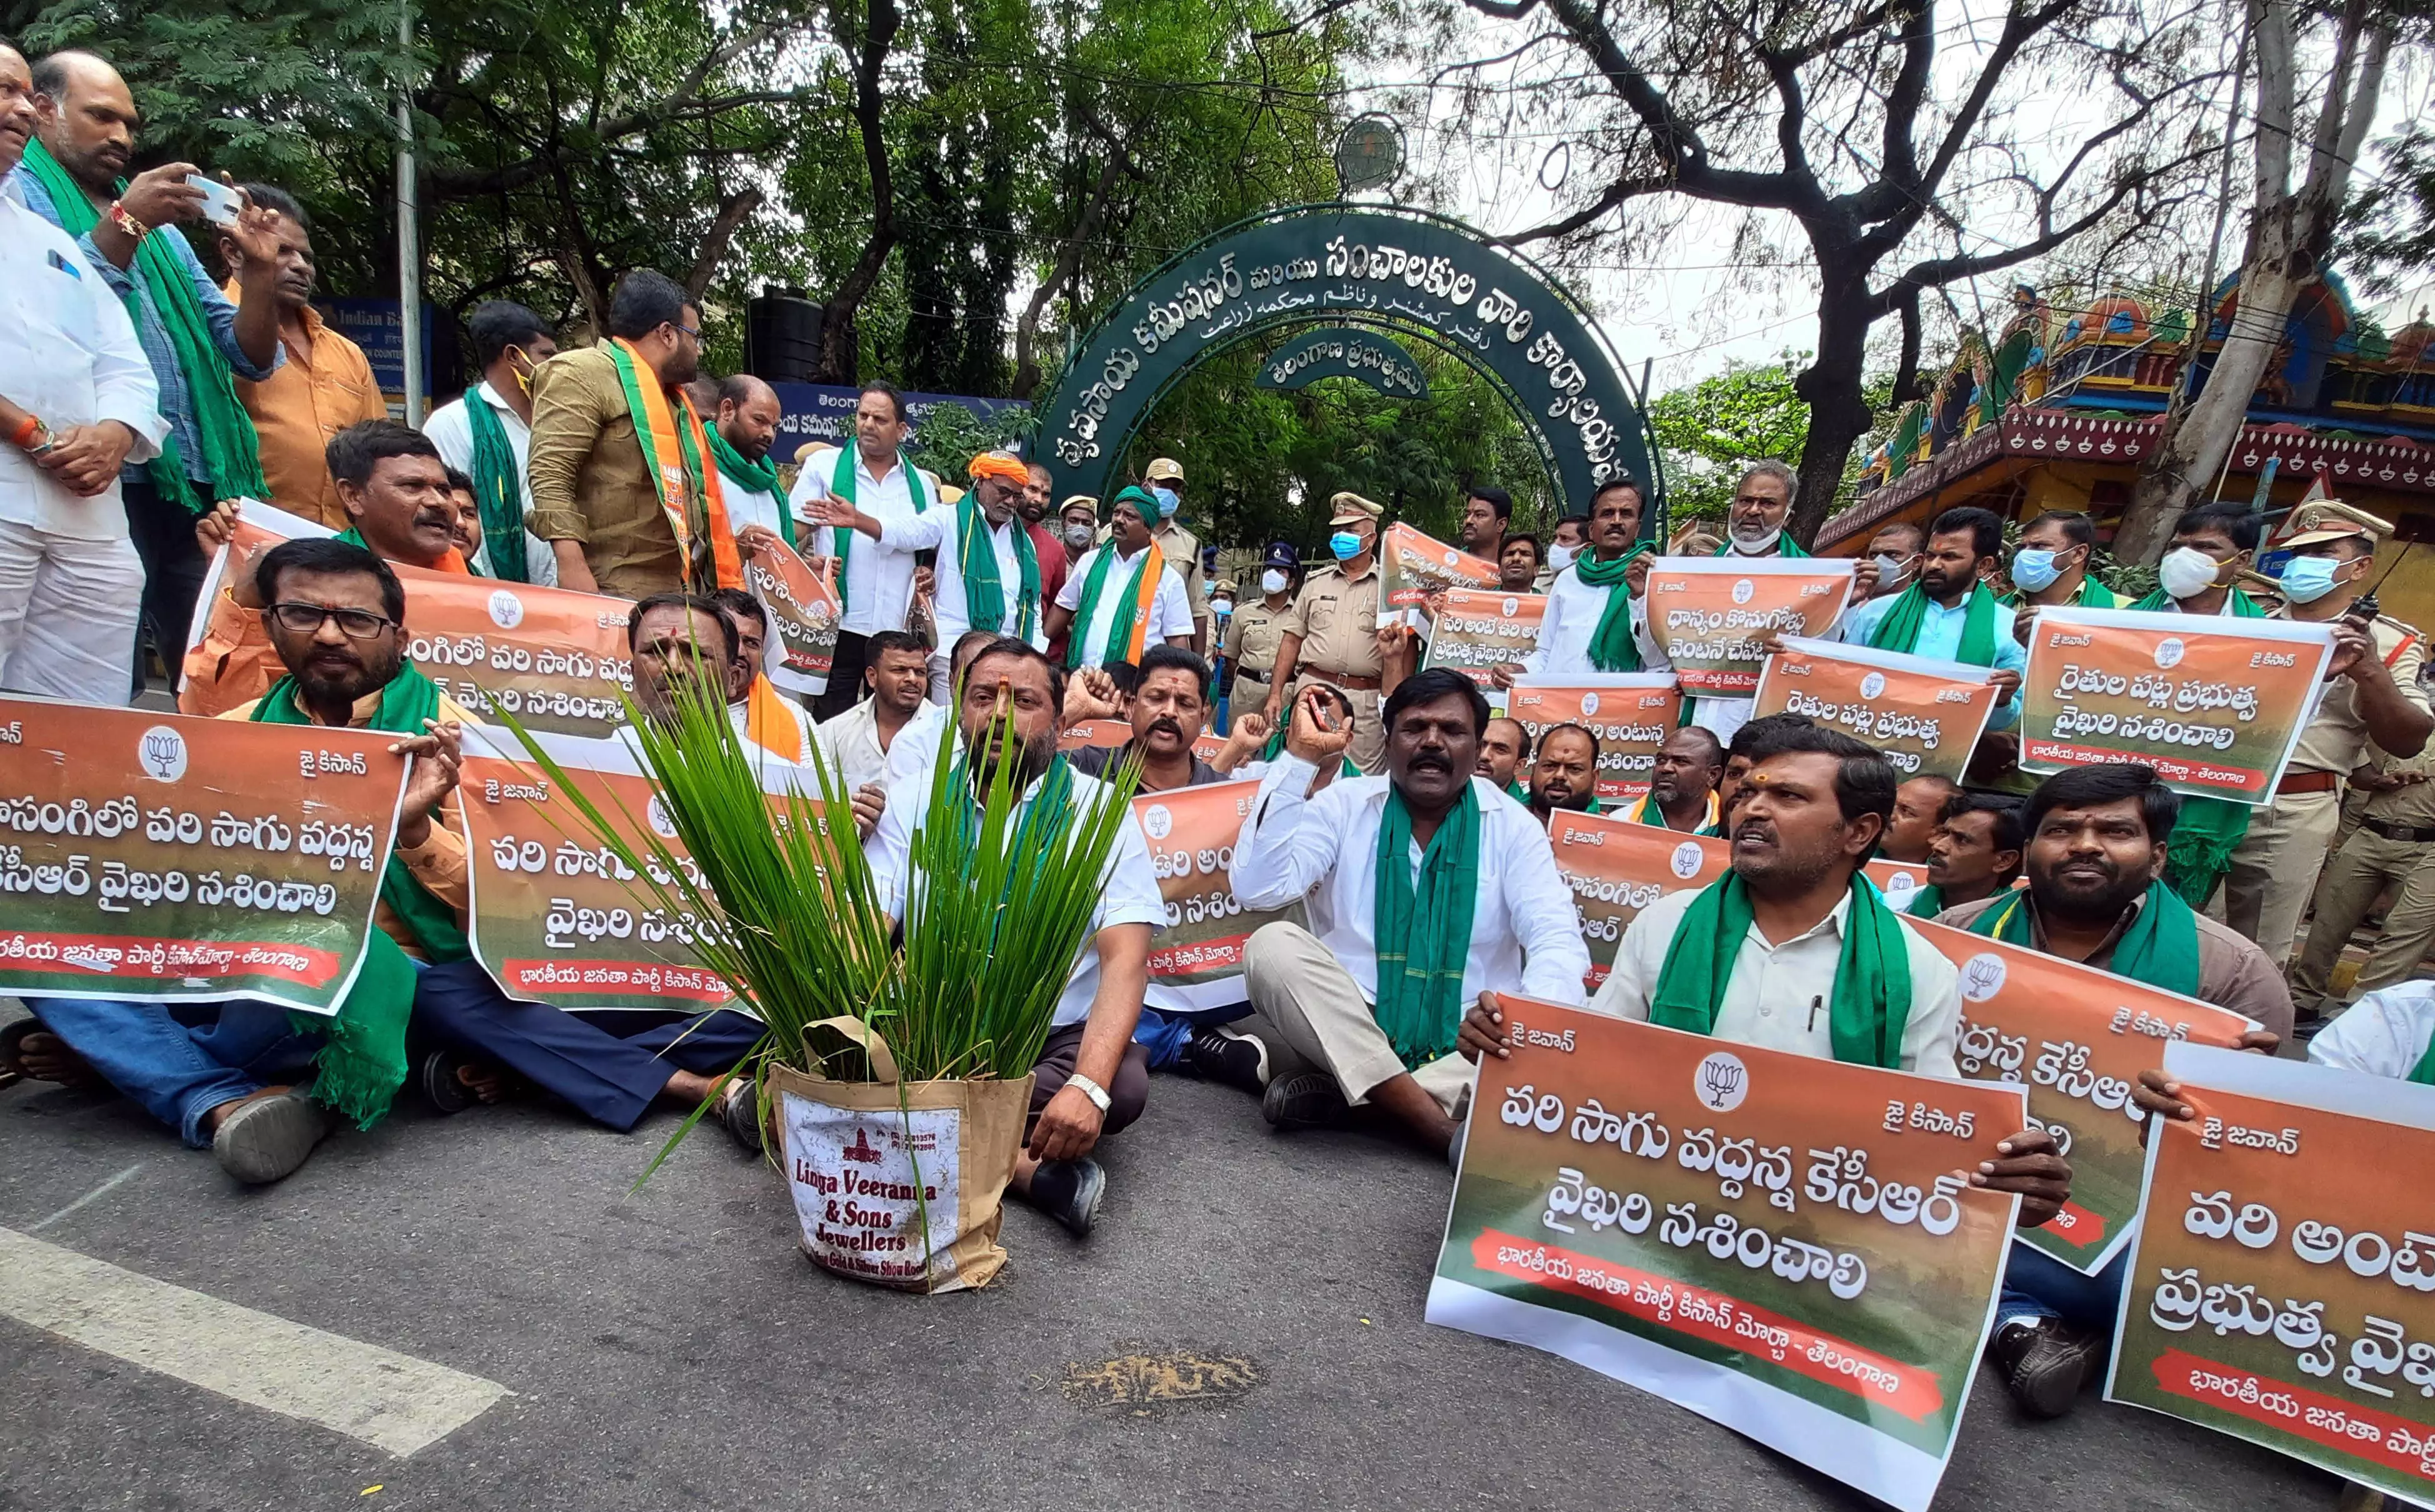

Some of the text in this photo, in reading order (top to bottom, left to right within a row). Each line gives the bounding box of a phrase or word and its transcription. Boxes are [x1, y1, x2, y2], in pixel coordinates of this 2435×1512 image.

[1132, 252, 1242, 353] కమీషనర్
[1249, 257, 1317, 290] మరియు
[1326, 236, 1476, 305] సంచాలకుల
[1477, 288, 1533, 342] వారి
[339, 311, 382, 326] Indian
[1268, 340, 1421, 396] తెలంగాణ ప్రభుత్వము
[1444, 617, 1520, 637] వరి అంటే ఉరి
[1667, 605, 1806, 639] ధాన్యం కొనుగోళ్లు
[1434, 640, 1473, 665] ప్రభుత్వ
[1473, 644, 1507, 666] వైఖరి
[1667, 637, 1724, 660] వెంటనే
[2050, 633, 2091, 648] జై జవాన్
[491, 644, 531, 672] వరి
[536, 648, 594, 679] సాగు
[2250, 652, 2296, 669] జై కిసాన్
[2054, 664, 2259, 722] రైతుల పట్ల ప్రభుత్వ
[1606, 722, 1665, 747] అంటున్న
[1840, 704, 1875, 735] పట్ల
[1874, 710, 1941, 749] ప్రభుత్వ
[2051, 705, 2236, 750] వైఖరి నశించాలి
[300, 750, 366, 777] జై కిసాన్
[2031, 745, 2074, 760] భారతీయ
[2198, 766, 2246, 784] తెలంగాణ
[485, 779, 499, 803] జై
[146, 806, 202, 844] వరి
[211, 810, 292, 851] సాగు
[299, 820, 374, 871] వద్దన్న
[1562, 827, 1605, 845] జై జవాన్
[489, 836, 546, 873] వరి
[1152, 845, 1191, 877] ఉరి
[98, 861, 190, 912] వైఖరి
[198, 871, 336, 915] నశించాలి
[545, 898, 632, 948] వైఖరి
[63, 944, 122, 964] జనతా
[127, 942, 166, 975] పార్టీ
[1152, 945, 1236, 973] పార్టీ కిసాన్ మోర్చా
[520, 964, 702, 993] భారతీయ జనతా పార్టీ కిసాన్
[2109, 1006, 2131, 1032] జై
[1511, 1022, 1576, 1054] జై జవాన్
[1883, 1100, 1975, 1139] జై కిసాన్
[2201, 1116, 2299, 1155] జై జవాన్
[796, 1158, 838, 1196] Linga
[1499, 1086, 1969, 1236] వరి సాగు వద్దన్న కేసీఆర్
[826, 1200, 892, 1228] & Sons
[2184, 1190, 2278, 1249] వరి
[816, 1223, 906, 1251] Jewellers
[1542, 1168, 1869, 1301] వైఖరి నశించాలి
[829, 1252, 847, 1269] Gold
[848, 1257, 855, 1268] &
[856, 1258, 879, 1273] Silver
[880, 1260, 903, 1276] Show
[1498, 1244, 1574, 1279] భారతీయ
[1576, 1264, 1631, 1296] జనతా
[1633, 1279, 1675, 1326] పార్టీ
[1678, 1290, 1732, 1330] కిసాన్
[1734, 1313, 1789, 1362] మోర్చా
[1806, 1340, 1901, 1394] తెలంగాణ
[2150, 1268, 2336, 1378] ప్రభుత్వ
[2189, 1368, 2299, 1418] భారతీయ
[2304, 1407, 2381, 1443] జనతా
